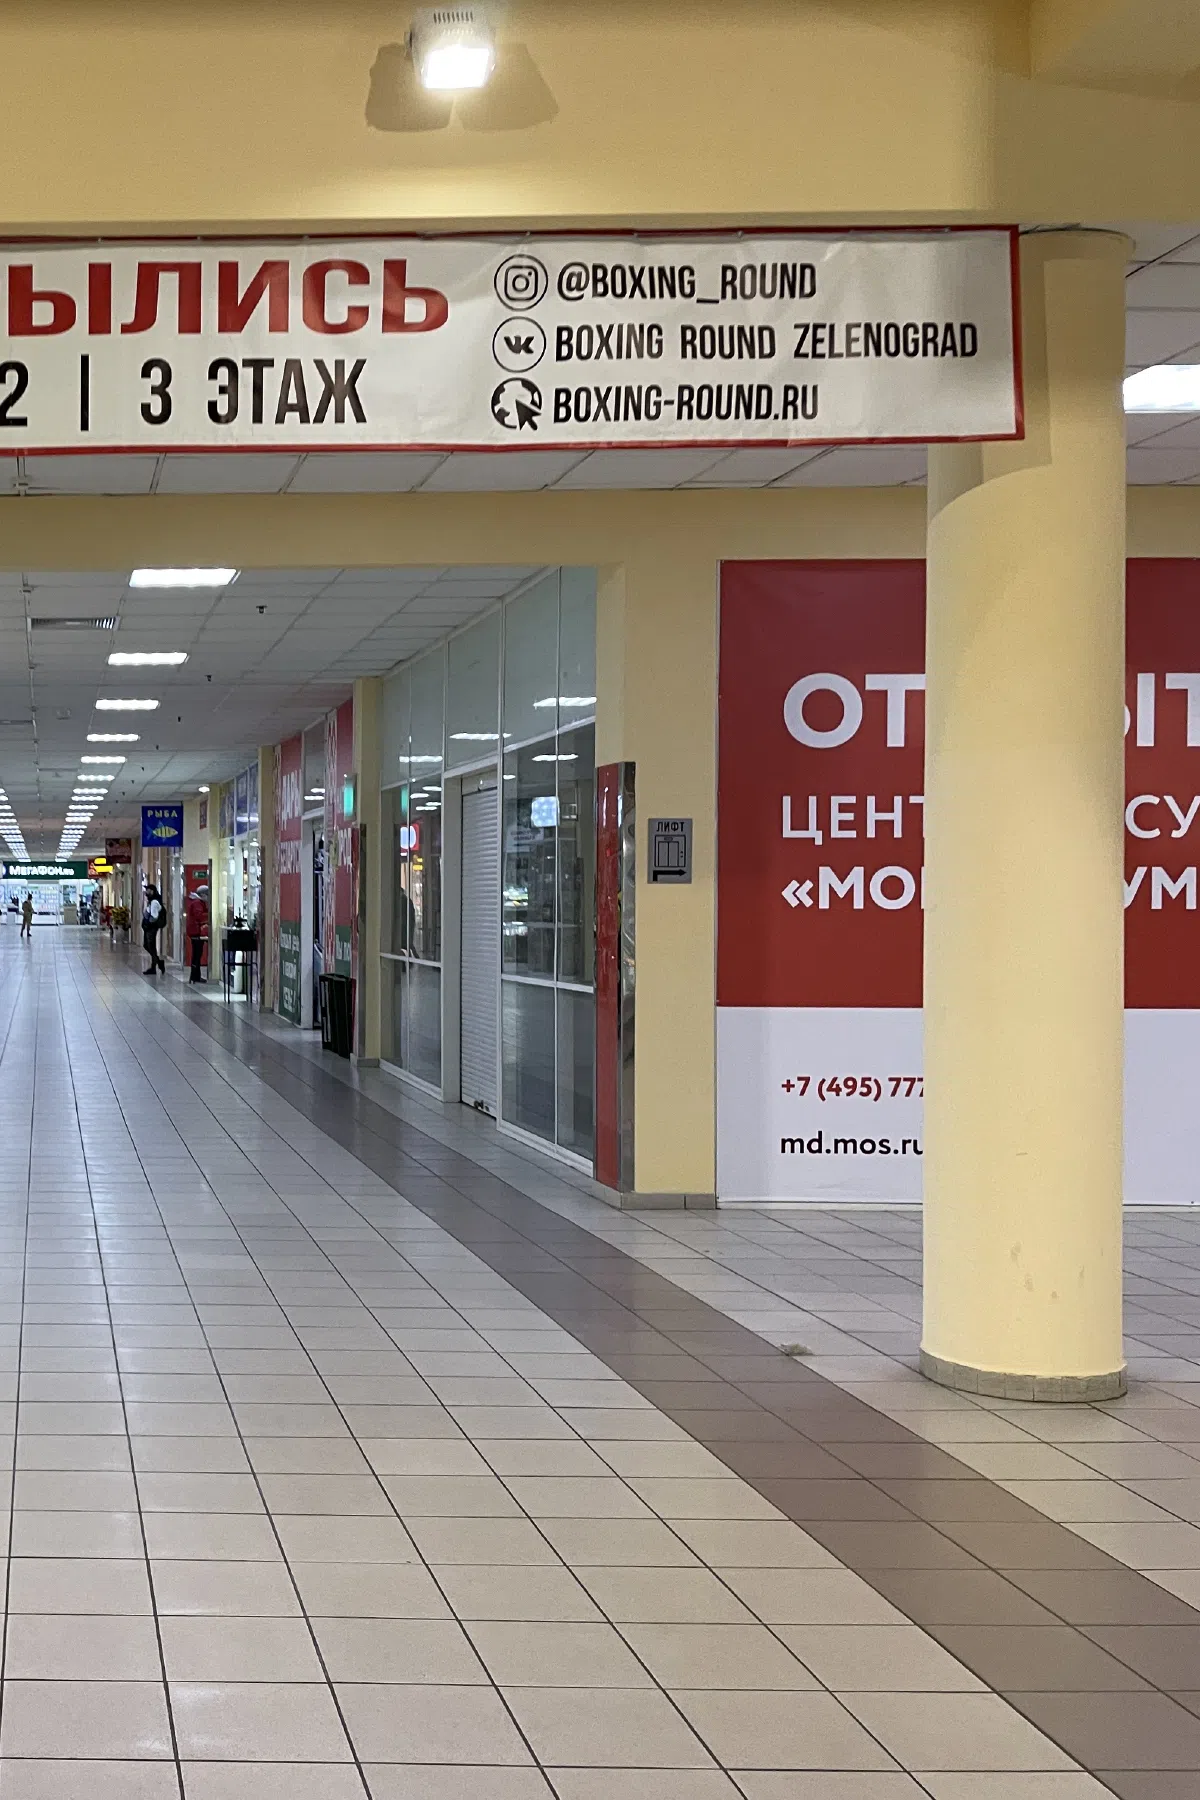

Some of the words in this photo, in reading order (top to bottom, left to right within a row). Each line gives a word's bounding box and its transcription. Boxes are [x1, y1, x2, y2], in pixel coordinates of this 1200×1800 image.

[556, 260, 817, 304] @BOXING_ROUND
[555, 324, 664, 362] BOXING
[680, 324, 776, 360] ROUND
[793, 322, 979, 359] ZELENOGRAD
[140, 358, 172, 426] 3
[206, 357, 368, 426] ЭТАЖ
[553, 384, 819, 424] BOXING-ROUND.RU
[147, 809, 178, 818] РЫБА
[656, 821, 685, 833] ЛИФТ
[781, 1076, 811, 1097] +7
[817, 1076, 882, 1102] (495)
[780, 1130, 924, 1155] md.mos.ru
